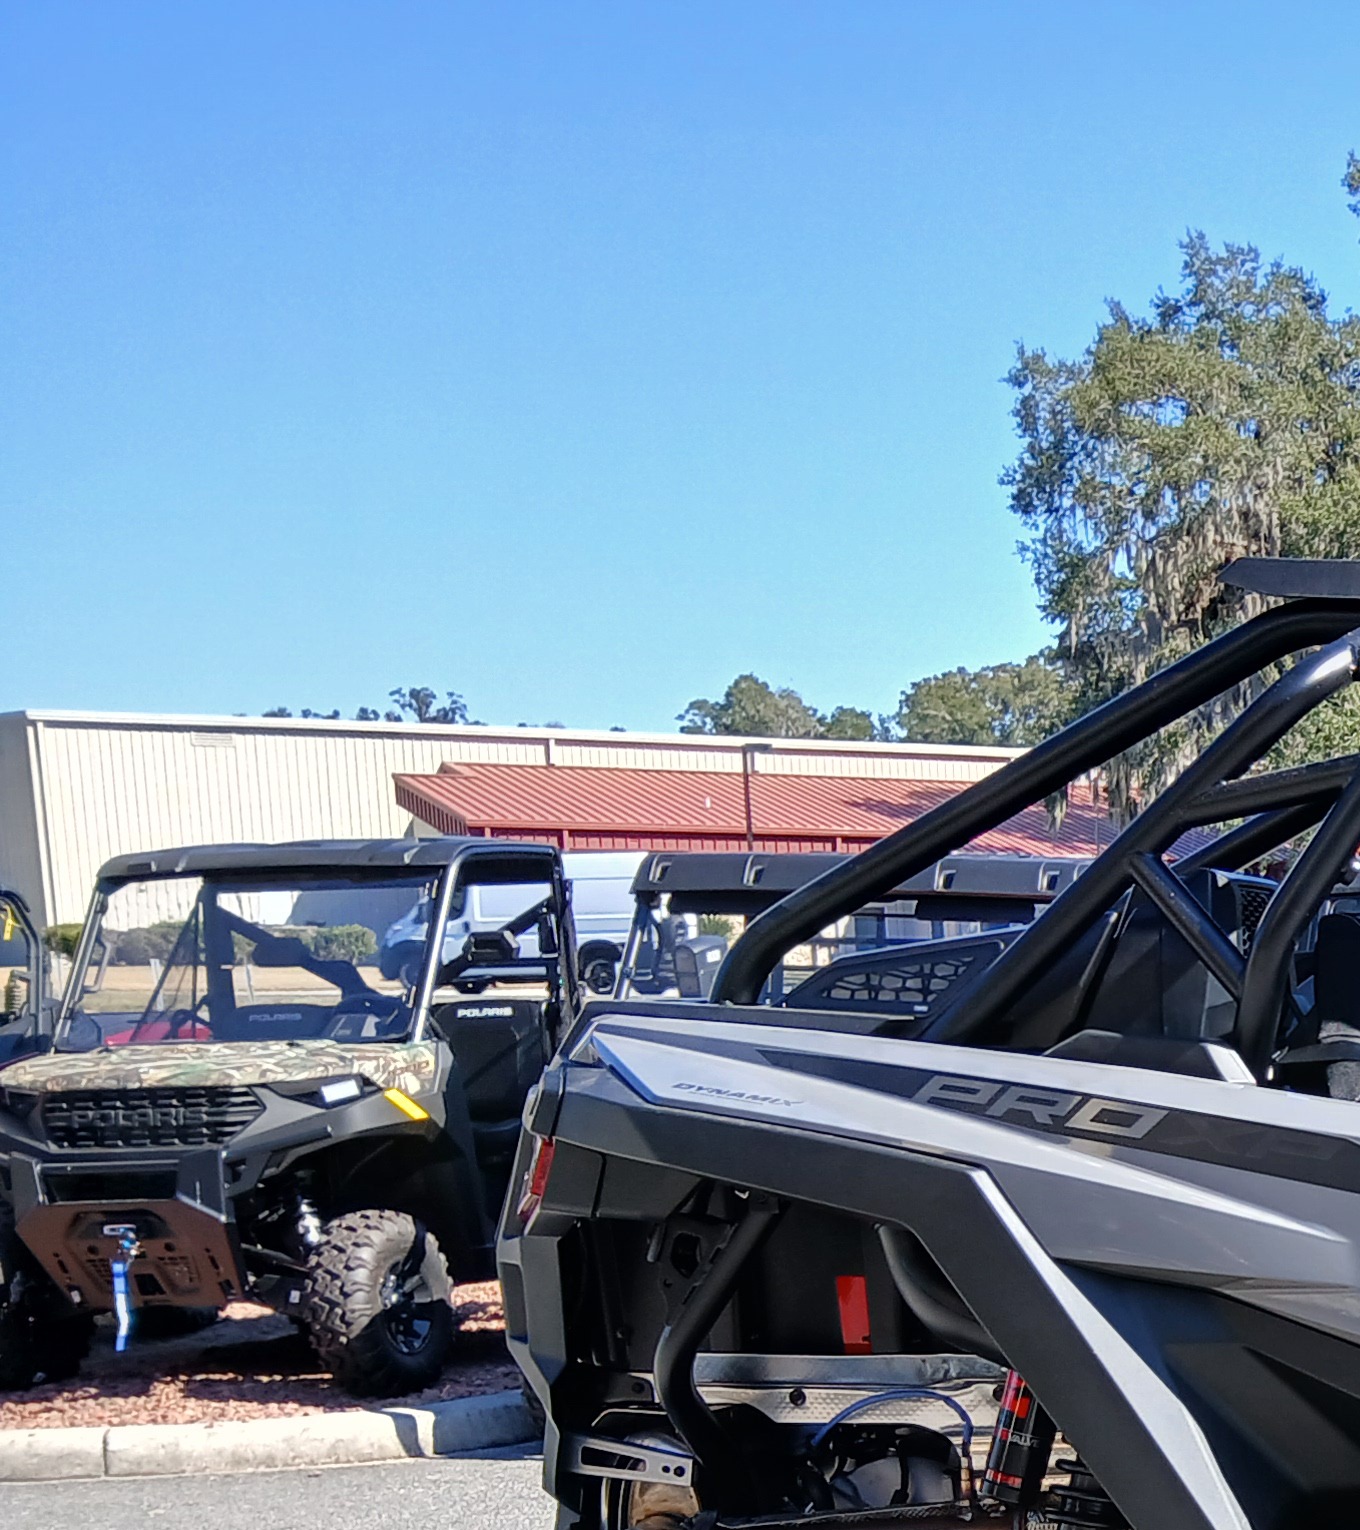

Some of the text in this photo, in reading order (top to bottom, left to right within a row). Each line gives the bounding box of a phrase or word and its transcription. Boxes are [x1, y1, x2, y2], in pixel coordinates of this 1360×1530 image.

[249, 1012, 303, 1022] POLARIS
[456, 1006, 514, 1018] POLARIS
[672, 1081, 805, 1107] DYNAMIX
[70, 1106, 208, 1128] POLARIS
[911, 1074, 1170, 1139] PRO
